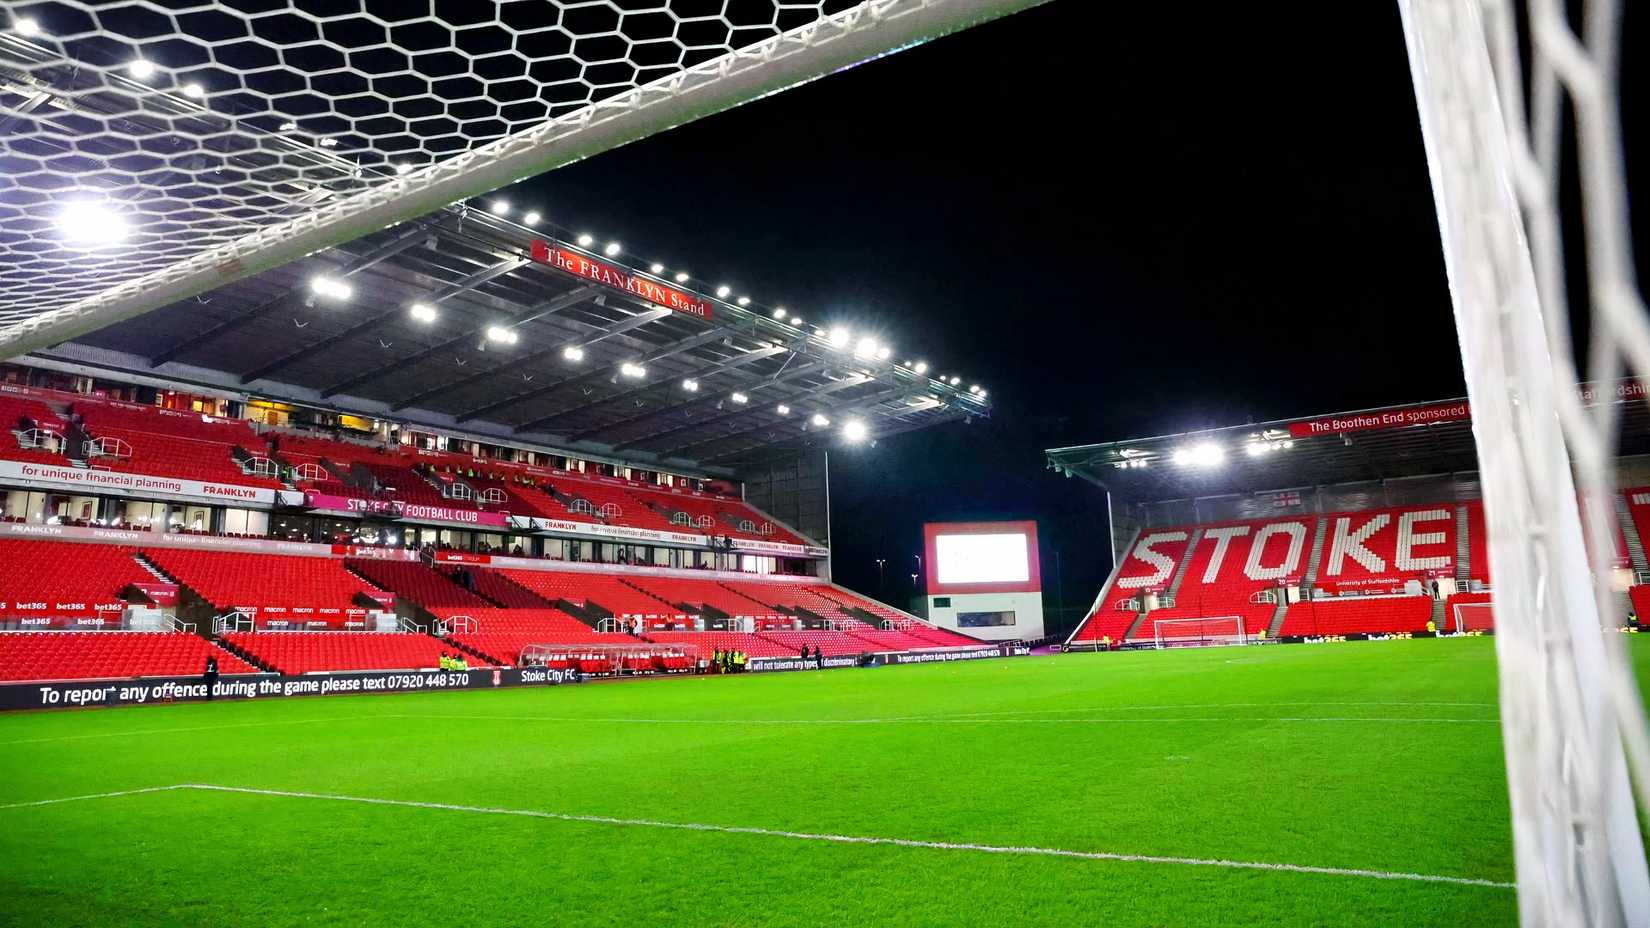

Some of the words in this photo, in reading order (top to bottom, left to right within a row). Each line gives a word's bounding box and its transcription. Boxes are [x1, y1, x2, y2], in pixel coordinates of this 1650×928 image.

[545, 247, 573, 270] The
[579, 259, 666, 304] FRANKLYN
[671, 293, 704, 316] Stand
[1310, 422, 1330, 432] The
[1333, 418, 1380, 430] Boothen
[1383, 412, 1404, 424] End
[1407, 405, 1465, 422] sponsored
[22, 465, 38, 476] for
[42, 469, 83, 481] unique
[86, 472, 133, 486] financial
[135, 479, 181, 491] planning
[203, 485, 256, 499] FRANKLYN
[406, 505, 453, 520] FOOTBALL
[455, 510, 478, 522] CLUB
[11, 525, 62, 536] FRANKLYN
[544, 521, 577, 531] FRANKLYN
[94, 530, 139, 540] FRANKLYN
[1118, 509, 1451, 589] STOKE
[16, 602, 47, 610] bet365
[56, 602, 85, 610] bet365
[94, 603, 122, 611] bet365
[764, 661, 773, 670] not
[774, 660, 794, 670] tolerate
[794, 660, 804, 670] any
[521, 670, 545, 682] Stoke
[547, 669, 564, 683] City
[564, 669, 576, 680] FC
[40, 687, 60, 704] To
[64, 685, 117, 705] repor
[119, 686, 148, 703] any
[152, 681, 208, 698] offence
[212, 680, 257, 698] during
[259, 679, 282, 694] the
[284, 680, 319, 695] game
[321, 677, 360, 694] please
[362, 675, 386, 690] text
[388, 675, 424, 689] 07920
[425, 673, 447, 687] 448
[449, 673, 469, 686] 570
